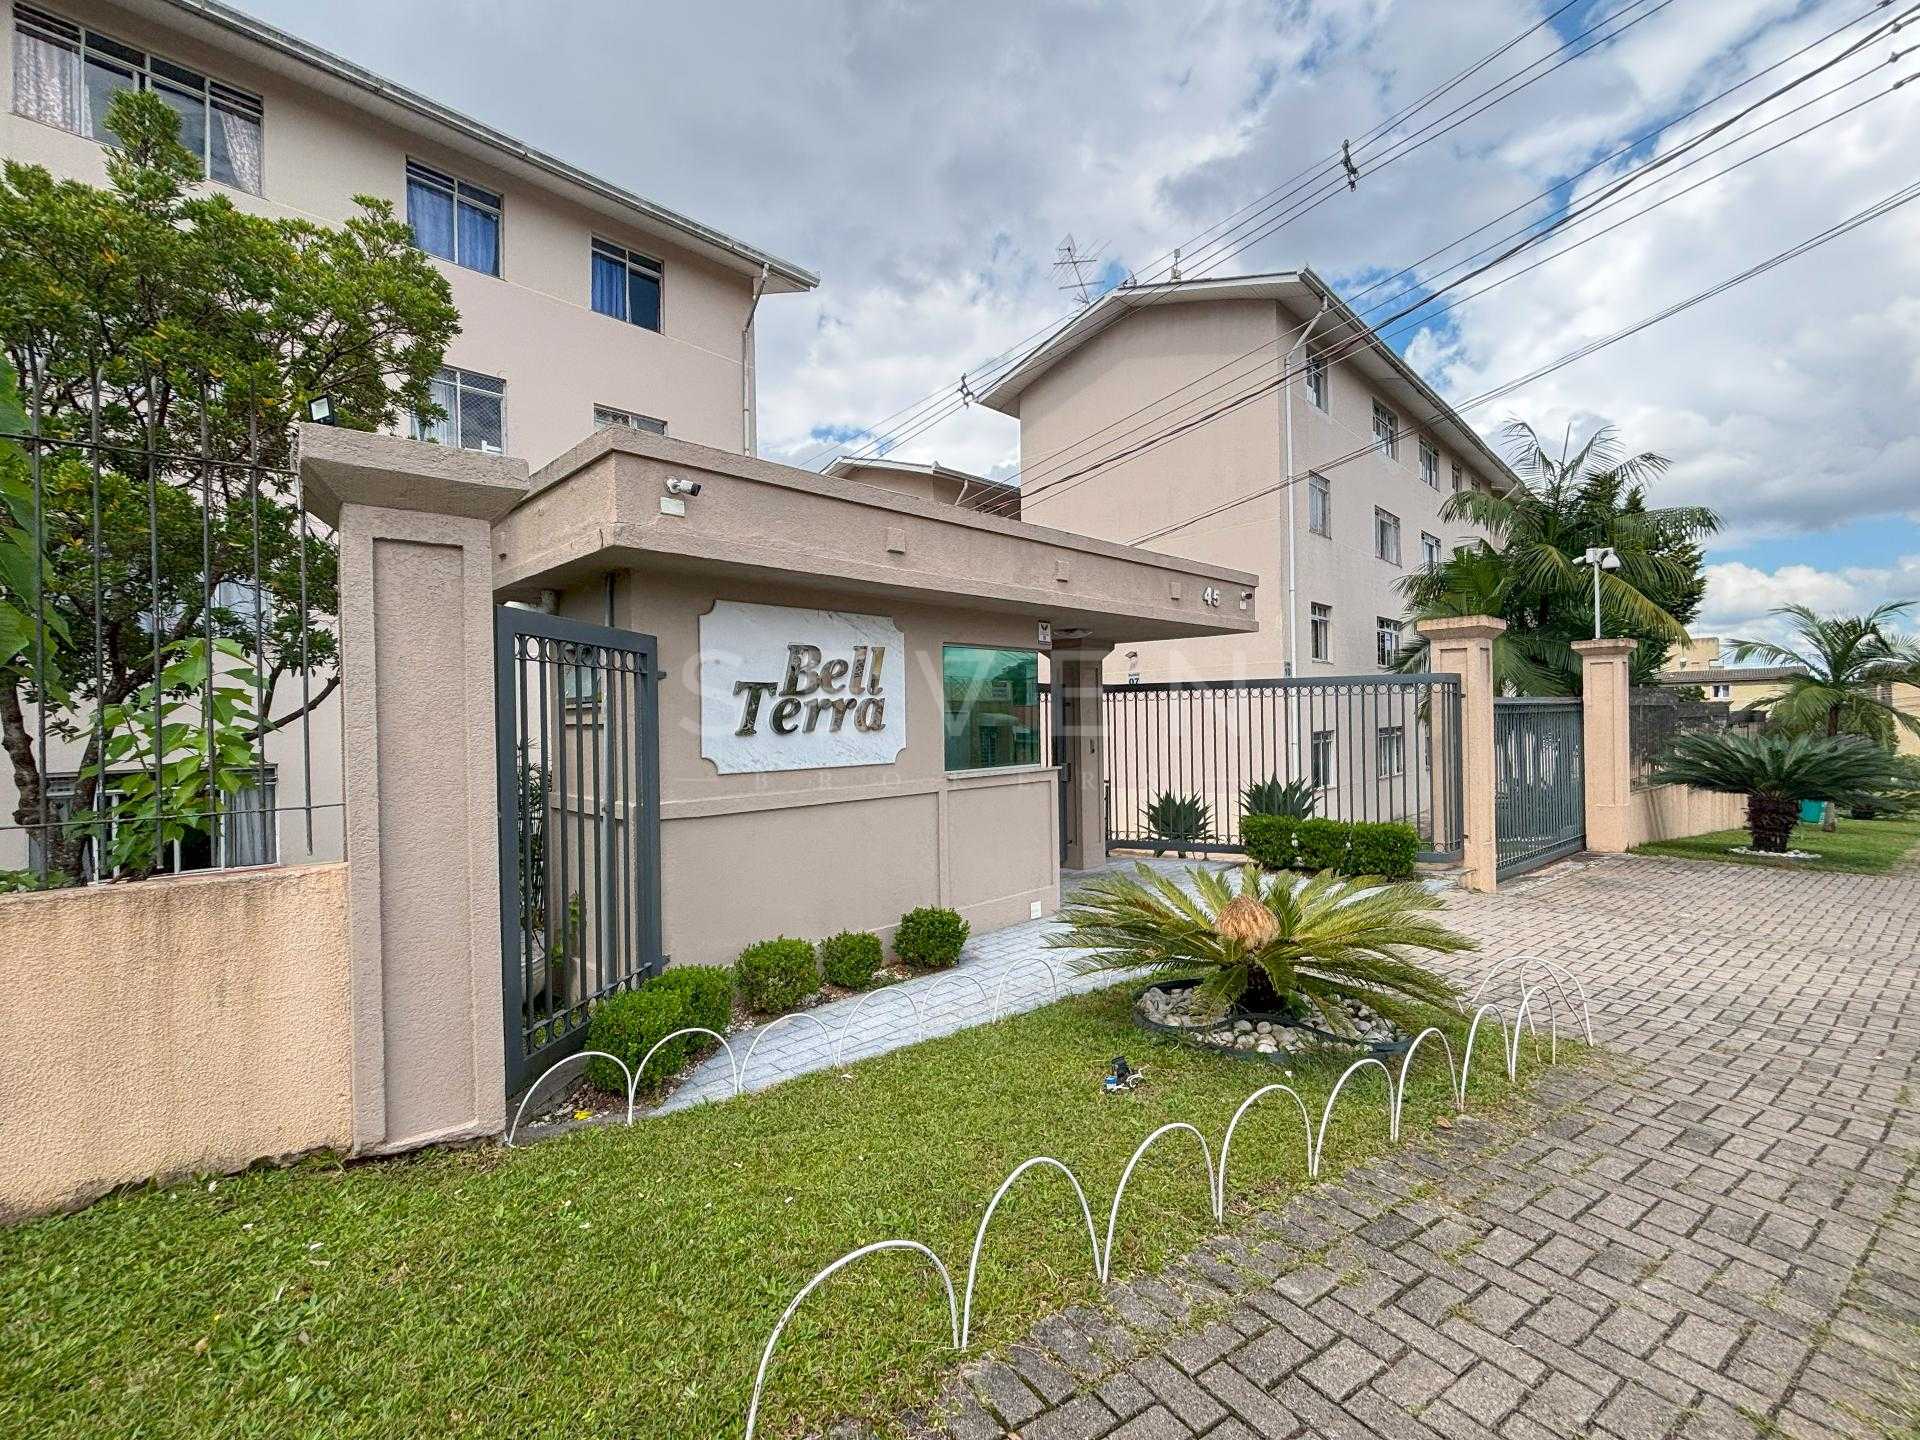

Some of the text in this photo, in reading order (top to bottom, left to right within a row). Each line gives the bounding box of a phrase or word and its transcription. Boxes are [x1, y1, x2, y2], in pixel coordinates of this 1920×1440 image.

[1202, 586, 1220, 607] 45
[778, 642, 886, 697] Bell
[732, 680, 886, 737] Terra
